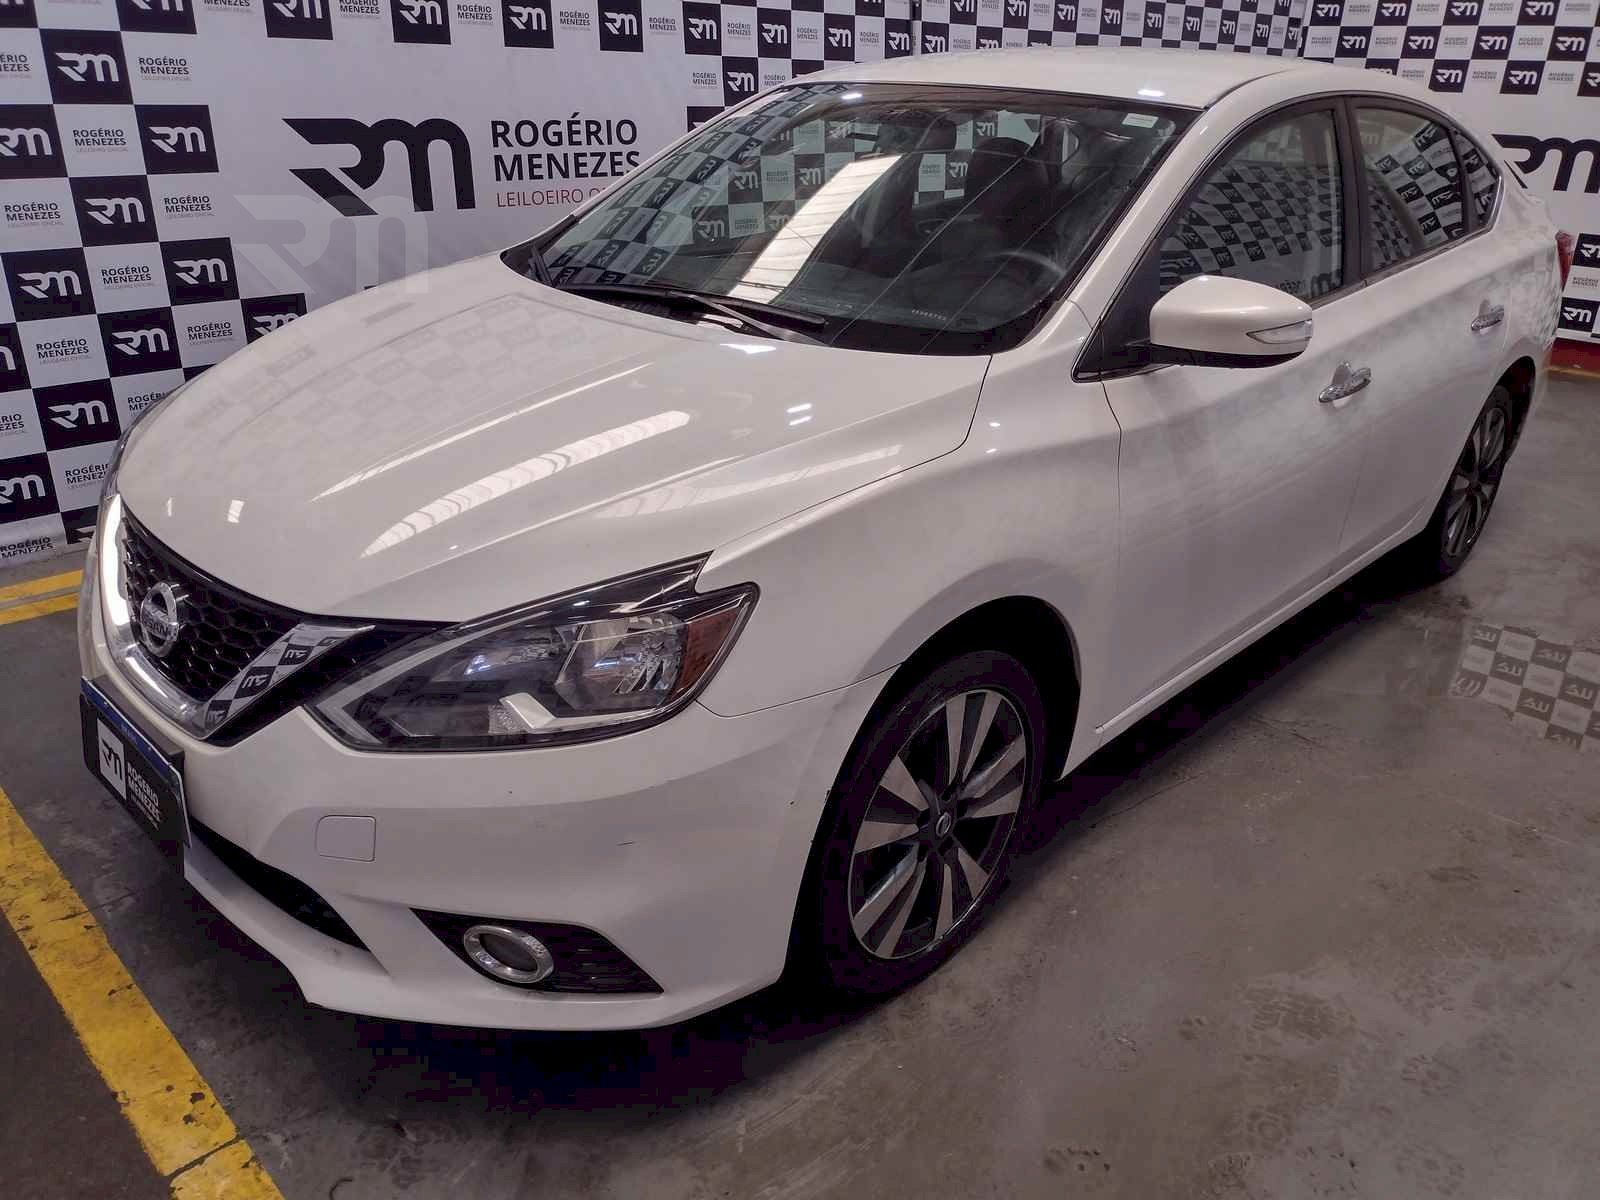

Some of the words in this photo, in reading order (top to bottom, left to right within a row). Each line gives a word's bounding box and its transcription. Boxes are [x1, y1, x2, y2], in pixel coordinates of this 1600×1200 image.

[340, 5, 380, 14] MENEZES
[398, 0, 443, 25] RM
[457, 3, 492, 13] ROGÉRIO
[559, 10, 590, 19] ROGÉRIO
[1057, 4, 1076, 21] RM
[1315, 3, 1339, 17] RM
[1381, 2, 1406, 17] RM
[1450, 1, 1478, 16] RM
[1525, 1, 1554, 16] RM
[457, 12, 493, 21] MENEZES
[508, 5, 547, 30] RM
[559, 18, 591, 26] MENEZES
[604, 12, 638, 35] RM
[649, 16, 676, 24] ROGÉRIO
[1103, 8, 1121, 25] RM
[688, 18, 717, 40] RM
[761, 23, 788, 45] RM
[828, 28, 851, 48] RM
[888, 31, 910, 51] RM
[1342, 35, 1366, 49] RM
[1408, 35, 1434, 50] RM
[1479, 35, 1507, 51] RM
[1555, 35, 1585, 52] RM
[55, 52, 119, 82] RM
[138, 56, 187, 67] ROGÉRIO
[140, 66, 189, 75] MENEZES
[1434, 69, 1463, 84] RM
[1508, 70, 1537, 85] RM
[727, 71, 755, 92] RM
[72, 128, 124, 138] ROGÉRIO
[490, 112, 638, 148] ROGÉRIO
[74, 138, 126, 147] MENEZES
[148, 126, 207, 153] RM
[282, 118, 476, 217] RM
[493, 150, 640, 182] MENEZES
[164, 195, 210, 205] ROGÉRIO
[496, 188, 584, 207] LEILOEIRO
[4, 202, 58, 213] ROGÉRIO
[84, 197, 146, 225] RM
[165, 203, 212, 213] MENEZES
[6, 211, 61, 221] MENEZES
[101, 265, 150, 276] ROGÉRIO
[173, 258, 228, 285] RM
[16, 270, 82, 299] RM
[102, 273, 152, 285] MENEZES
[1562, 306, 1592, 323] RM
[187, 321, 231, 333] ROGÉRIO
[112, 327, 169, 356] RM
[188, 329, 233, 341] MENEZES
[36, 339, 87, 352] ROGÉRIO
[38, 346, 89, 359] MENEZES
[48, 400, 109, 429] RM
[66, 472, 106, 485] MENEZ
